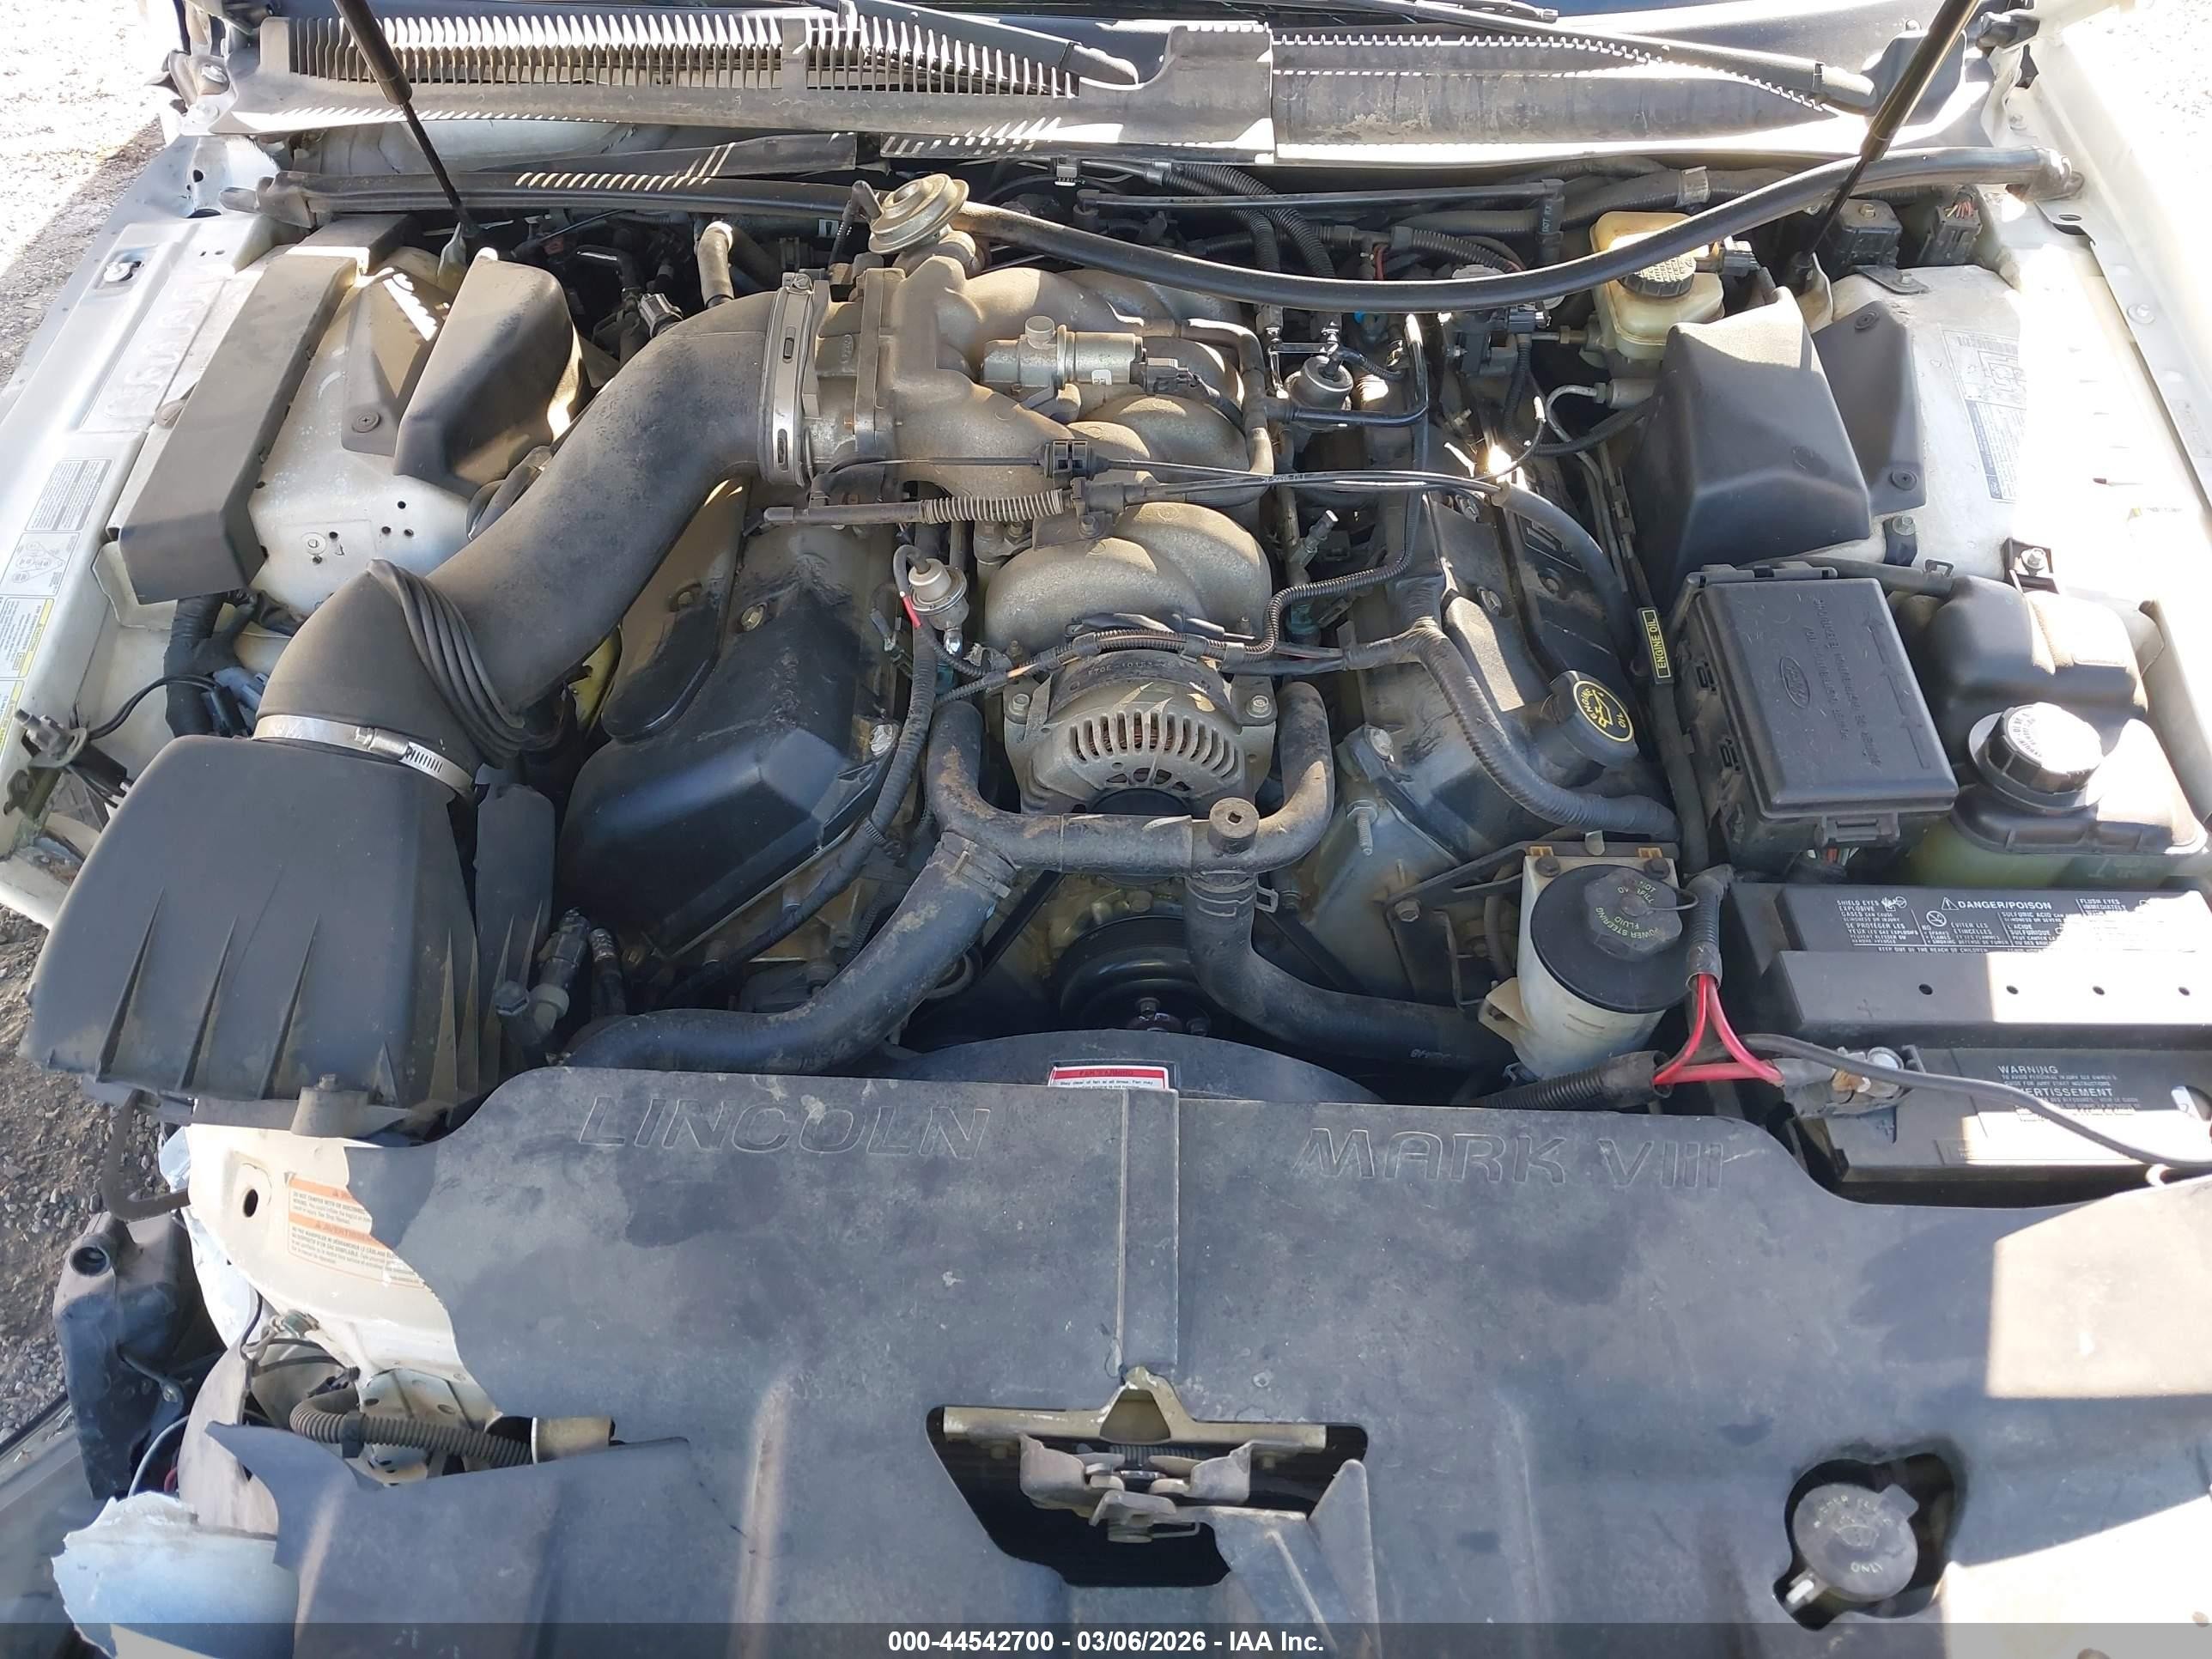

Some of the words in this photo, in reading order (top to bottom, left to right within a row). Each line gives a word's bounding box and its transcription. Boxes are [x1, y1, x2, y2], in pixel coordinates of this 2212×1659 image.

[1648, 618, 1659, 633] OIL
[1651, 635, 1666, 669] ENGINE
[1581, 688, 1598, 720] ENGINE
[1616, 714, 1626, 728] OIL
[1958, 901, 2052, 909] DANGER/POISON
[1595, 907, 1628, 937] STEERING
[1613, 915, 1640, 930] FLUID
[1631, 927, 1659, 940] POWER
[1997, 1066, 2058, 1074] WARNING
[578, 1098, 993, 1160] LINCOLN
[1291, 1127, 1567, 1185] MARK
[1596, 1138, 1723, 1190] VIII
[1850, 1561, 1883, 1573] ONLY
